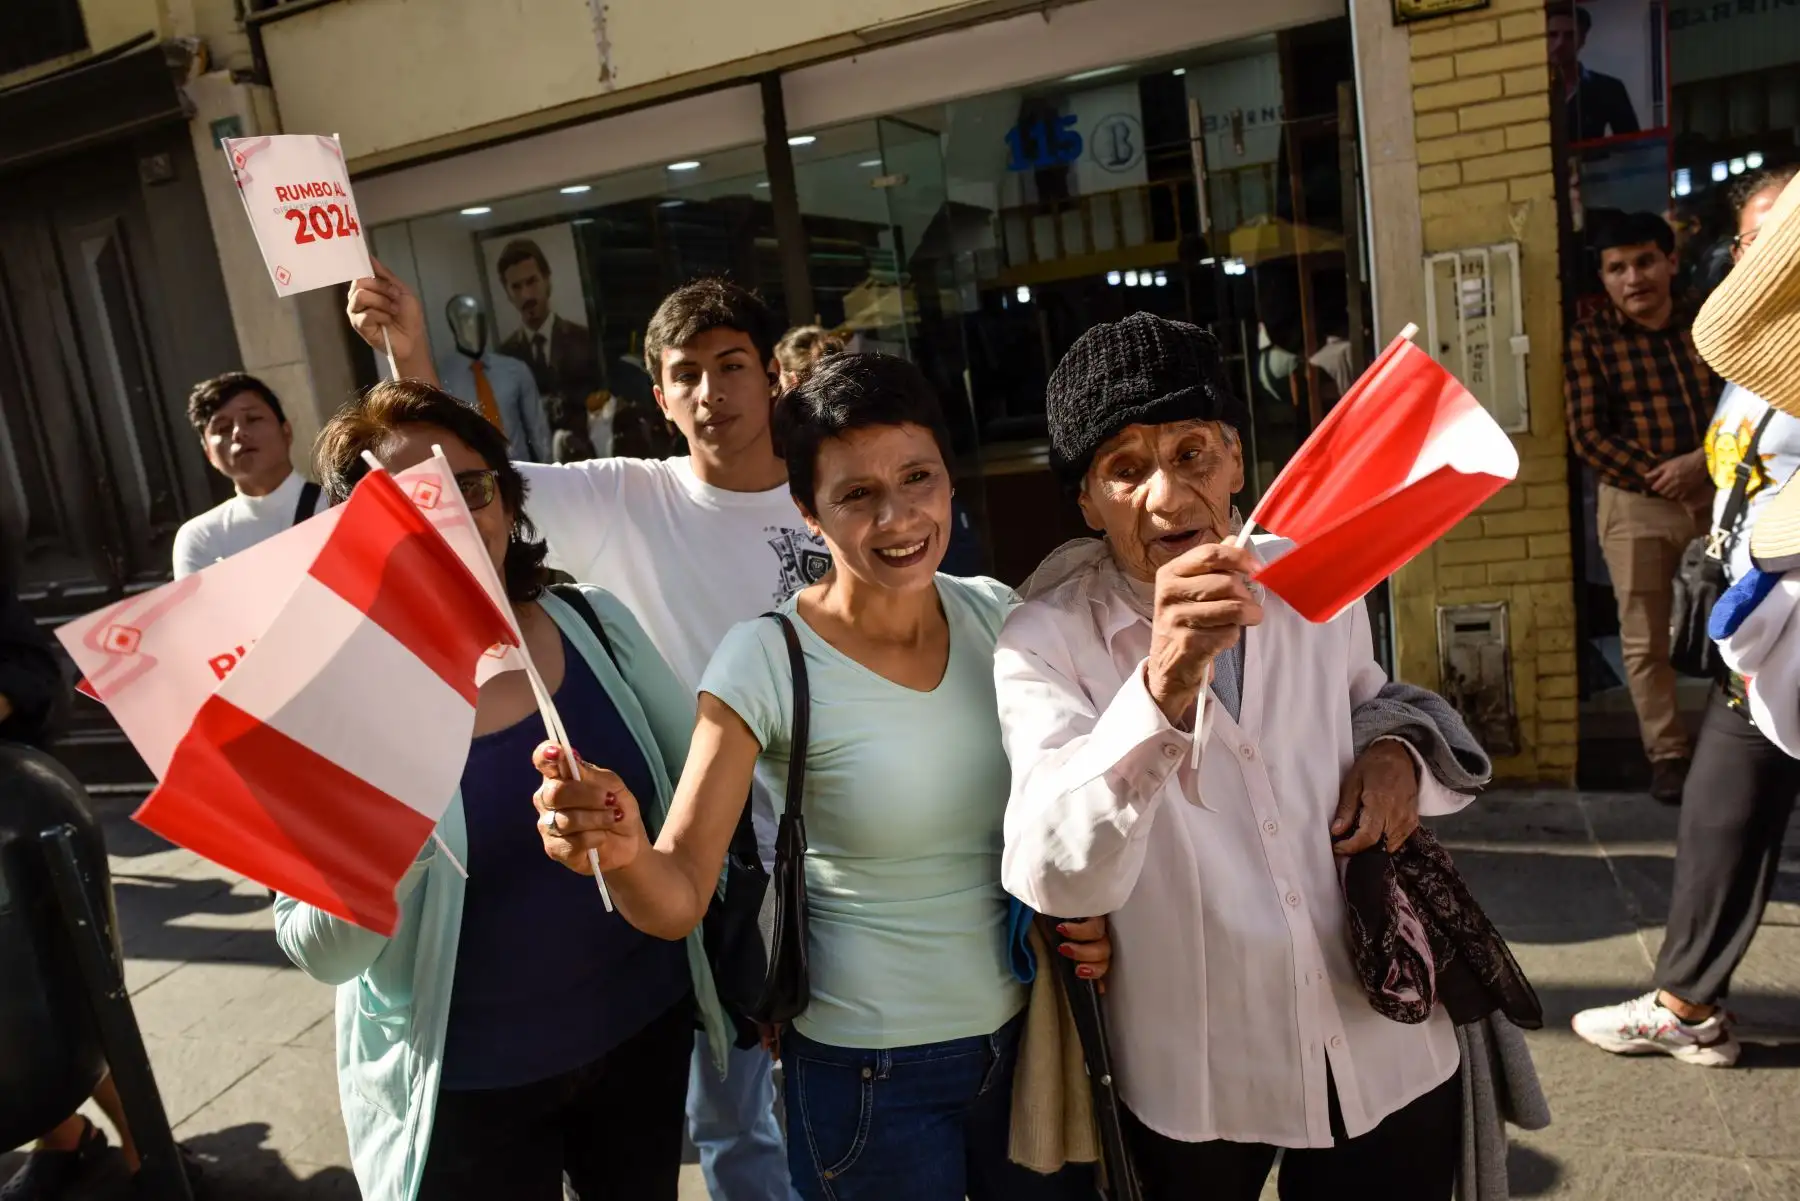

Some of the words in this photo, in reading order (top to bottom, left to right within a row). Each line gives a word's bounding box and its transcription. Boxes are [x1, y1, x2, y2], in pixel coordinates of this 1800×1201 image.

[1004, 114, 1082, 171] 115
[275, 182, 332, 202] RUMBO
[333, 181, 346, 197] AL
[285, 202, 359, 244] 2024
